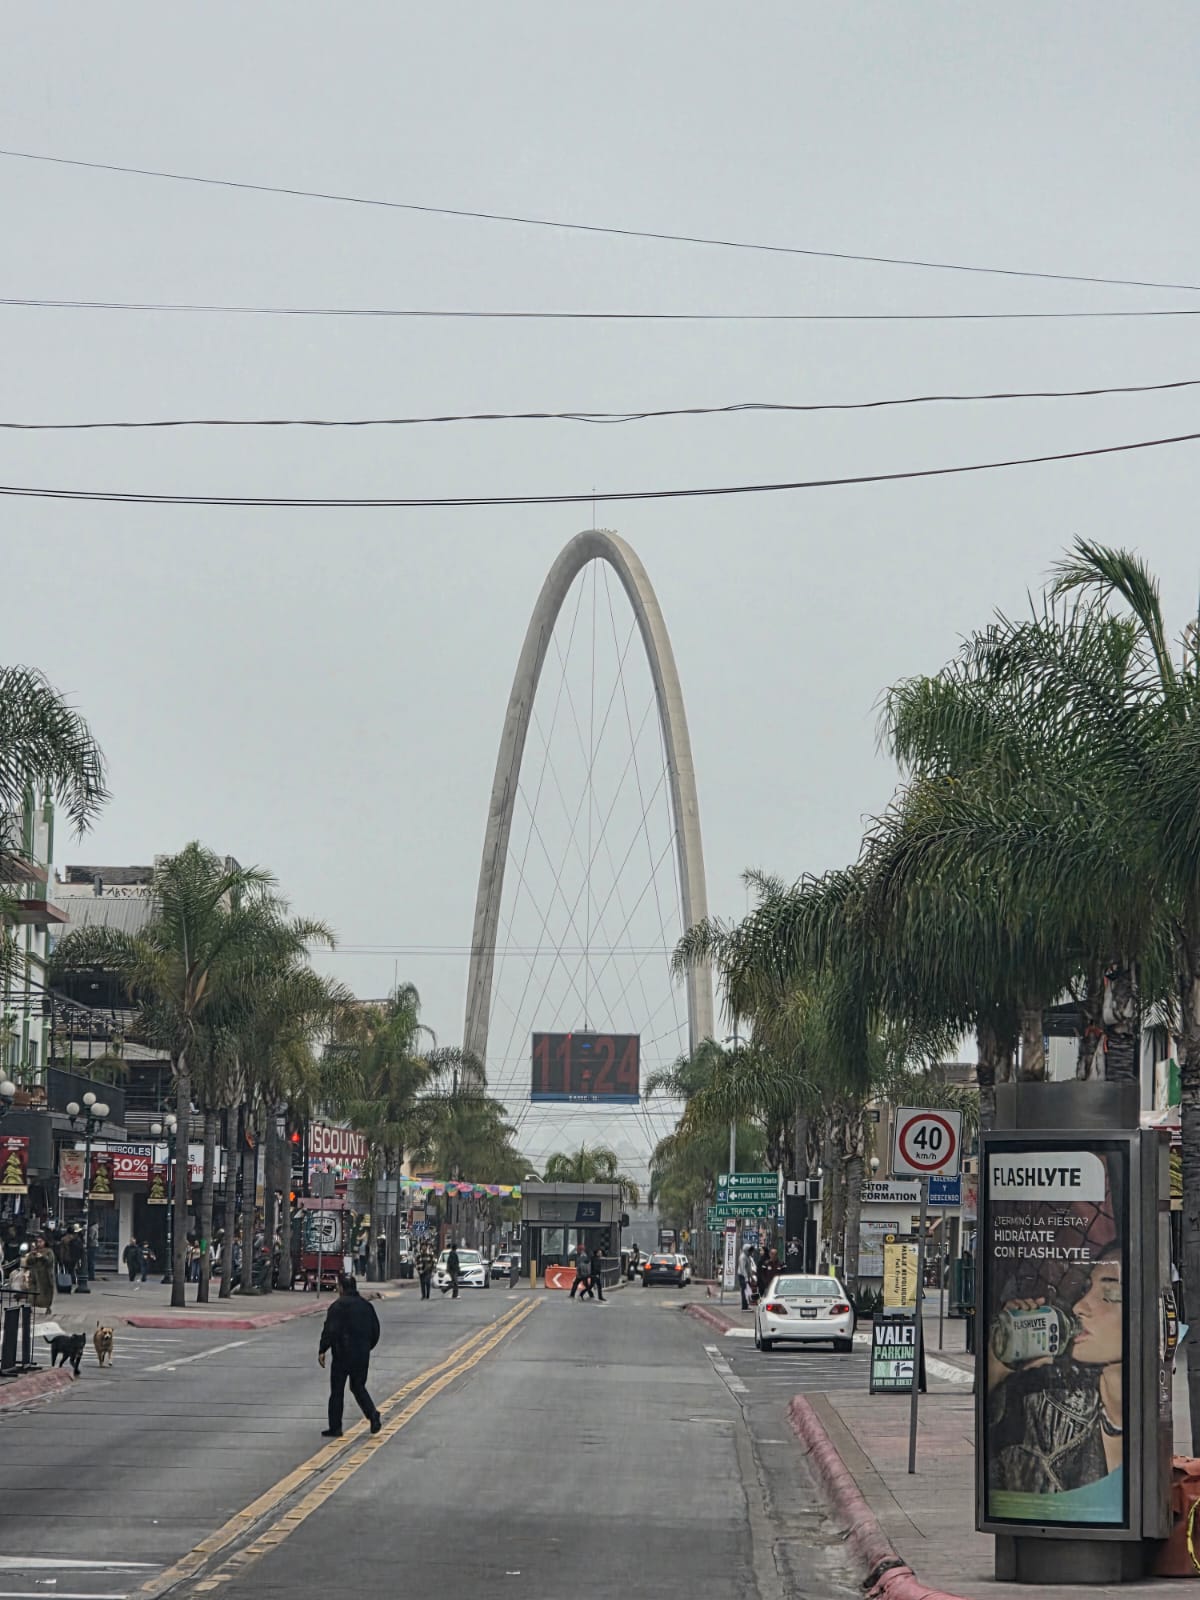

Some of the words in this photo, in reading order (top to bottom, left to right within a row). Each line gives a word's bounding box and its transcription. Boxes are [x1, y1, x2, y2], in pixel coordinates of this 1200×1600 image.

[309, 1124, 366, 1156] ISCOUNT
[914, 1126, 942, 1150] 40
[916, 1152, 937, 1160] km/h
[993, 1167, 1082, 1187] FLASHLYTE
[861, 1183, 889, 1191] SITOR
[861, 1192, 917, 1200] FORMATION
[1033, 1217, 1045, 1226] LA
[1047, 1217, 1089, 1226] FIESTA?
[994, 1228, 1055, 1242] HIDRÁTATE
[994, 1246, 1016, 1258] CON
[1018, 1247, 1091, 1259] FLASHLYTE
[1013, 1318, 1047, 1330] FLASHLYTE
[875, 1326, 915, 1345] VALET
[874, 1346, 914, 1360] PARKIN
